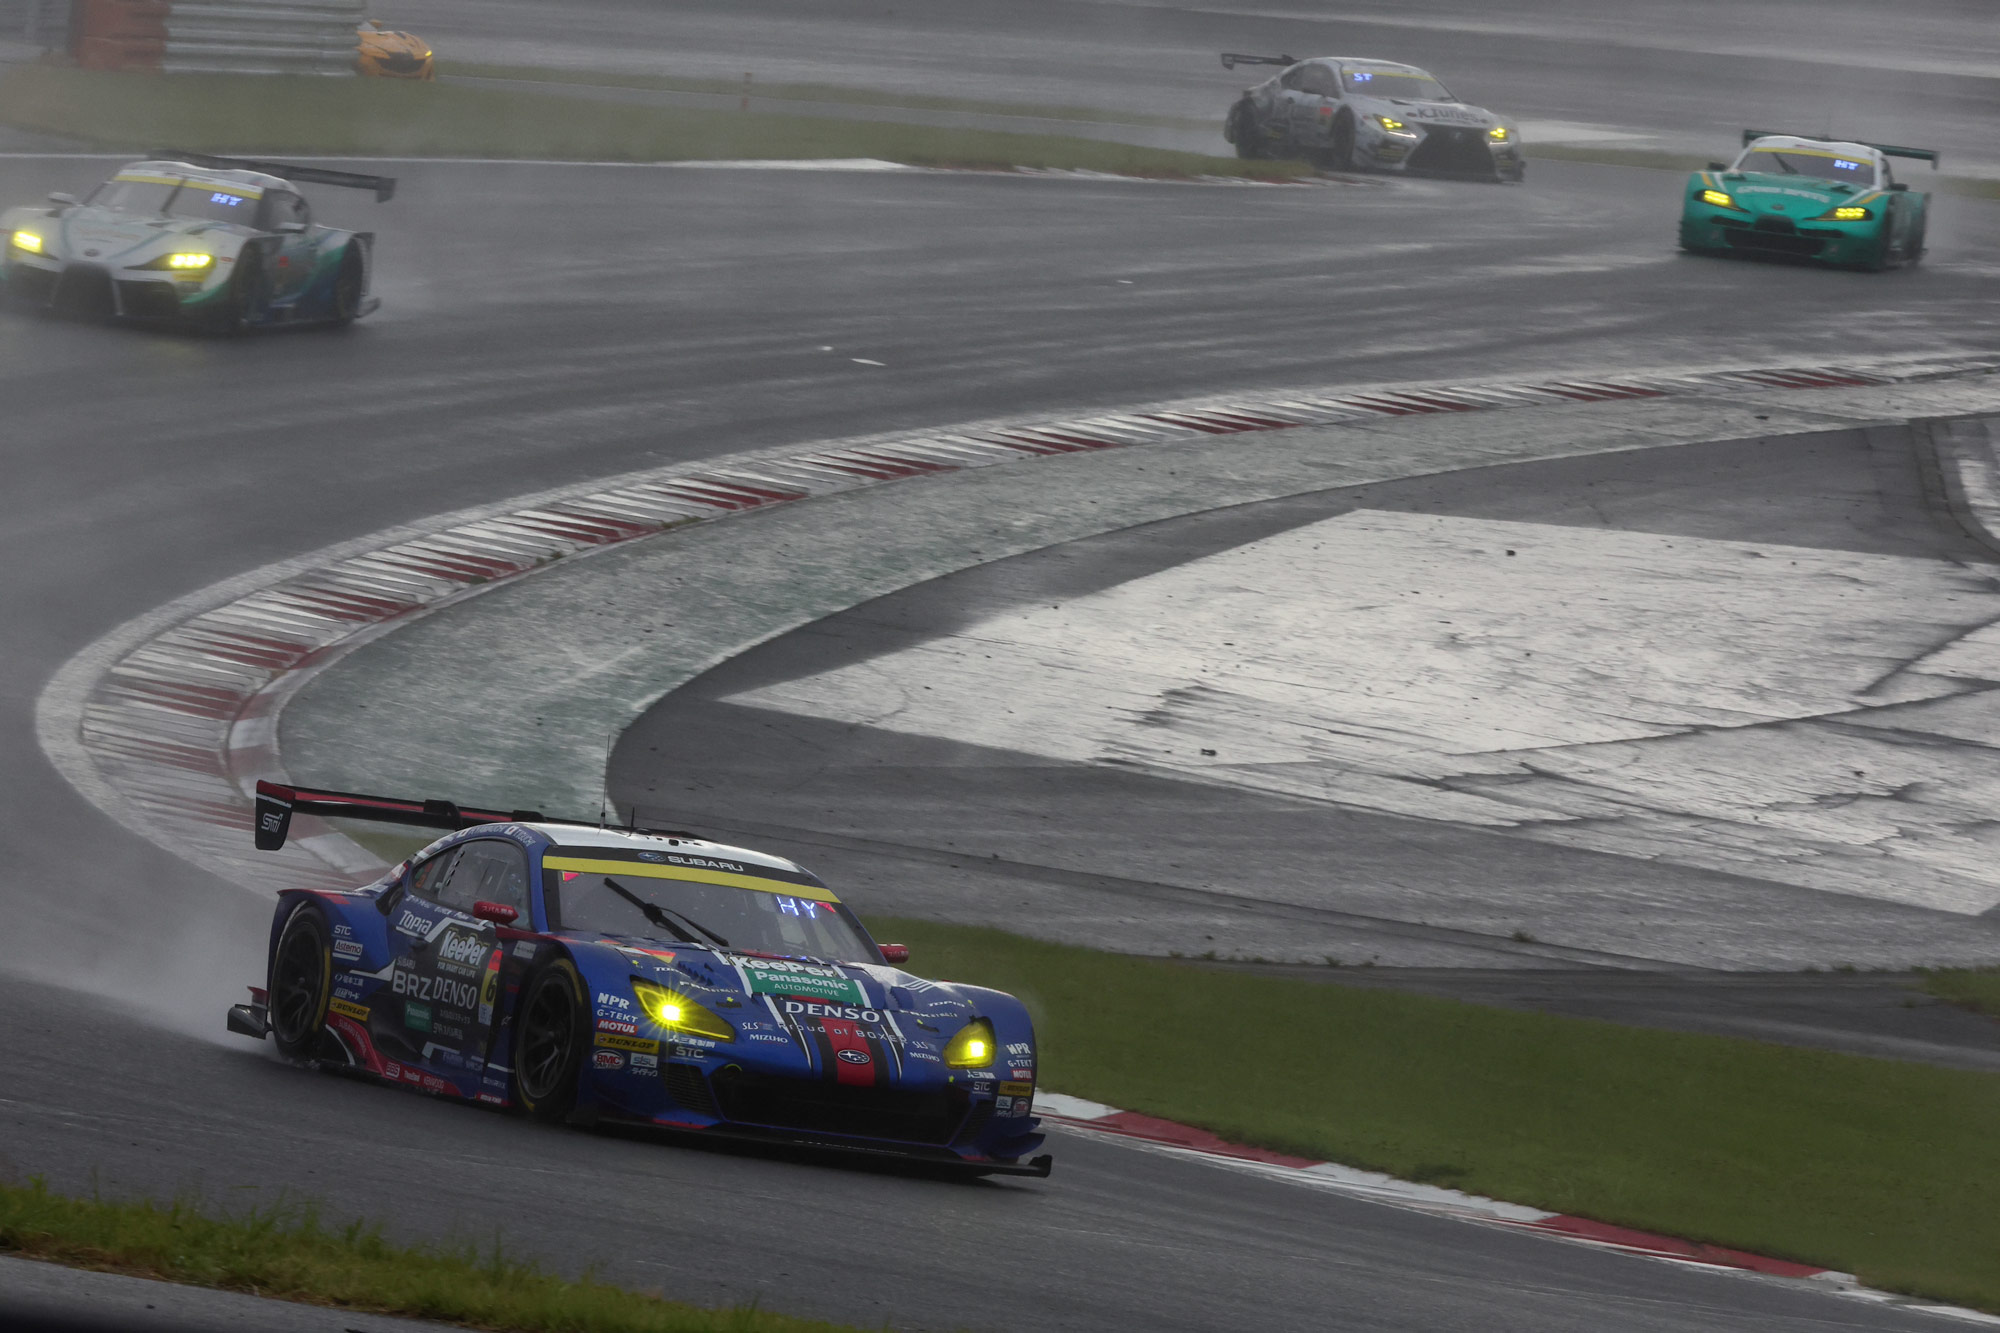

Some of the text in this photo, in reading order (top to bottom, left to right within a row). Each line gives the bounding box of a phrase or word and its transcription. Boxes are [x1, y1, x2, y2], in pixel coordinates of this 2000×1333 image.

[667, 856, 744, 872] SUBARU
[776, 896, 816, 918] HY
[334, 925, 352, 936] STC
[336, 942, 362, 955] Astemo
[438, 930, 489, 966] KeePer
[730, 956, 834, 978] KeePer
[392, 970, 432, 1001] BRZ
[754, 971, 848, 990] Panasonic
[432, 976, 478, 1010] DENSO
[774, 983, 840, 996] AUTOMOTIVE
[597, 993, 630, 1010] NPR
[597, 1009, 638, 1022] G-TEKT
[786, 1001, 880, 1022] DENSO
[598, 1020, 636, 1034] MOTUL
[742, 1022, 758, 1030] SLS
[750, 1034, 788, 1044] MIZUHO
[778, 1022, 826, 1033] Proud
[834, 1026, 848, 1036] of
[856, 1030, 908, 1045] BOXER
[606, 1037, 655, 1050] DUNLOP
[1006, 1042, 1032, 1055] NPR
[596, 1054, 621, 1065] BMC
[676, 1047, 704, 1059] STC
[973, 1082, 990, 1091] STC
